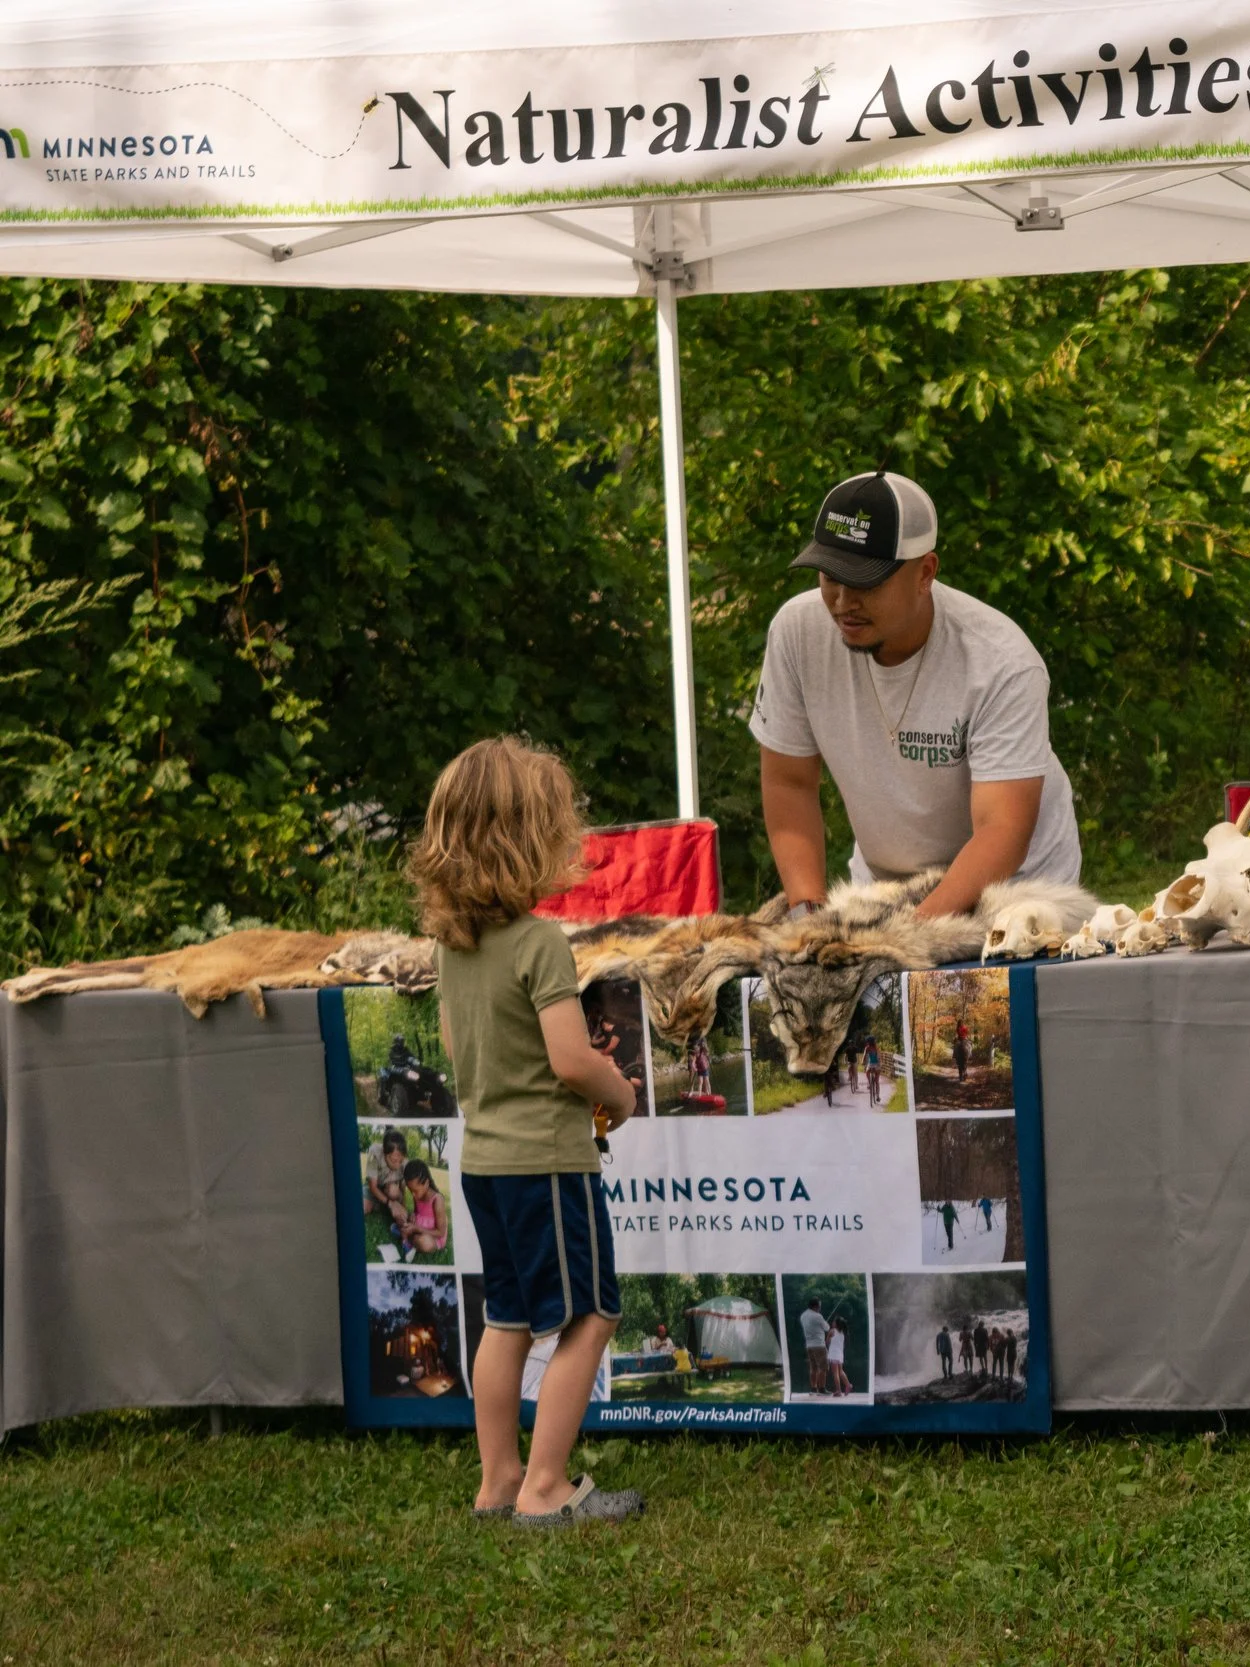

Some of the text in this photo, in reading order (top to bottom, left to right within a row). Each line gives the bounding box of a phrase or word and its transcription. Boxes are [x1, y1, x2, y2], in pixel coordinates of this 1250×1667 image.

[385, 73, 830, 171] Naturalist
[43, 134, 213, 159] MINNESOTA
[46, 164, 256, 182] STATE PARKS AND TRAILS
[899, 743, 950, 768] corps
[612, 1214, 864, 1232] TATE PARKS AND TRAILS
[600, 1405, 787, 1423] mnDNR.gov/ParksAndTrails
